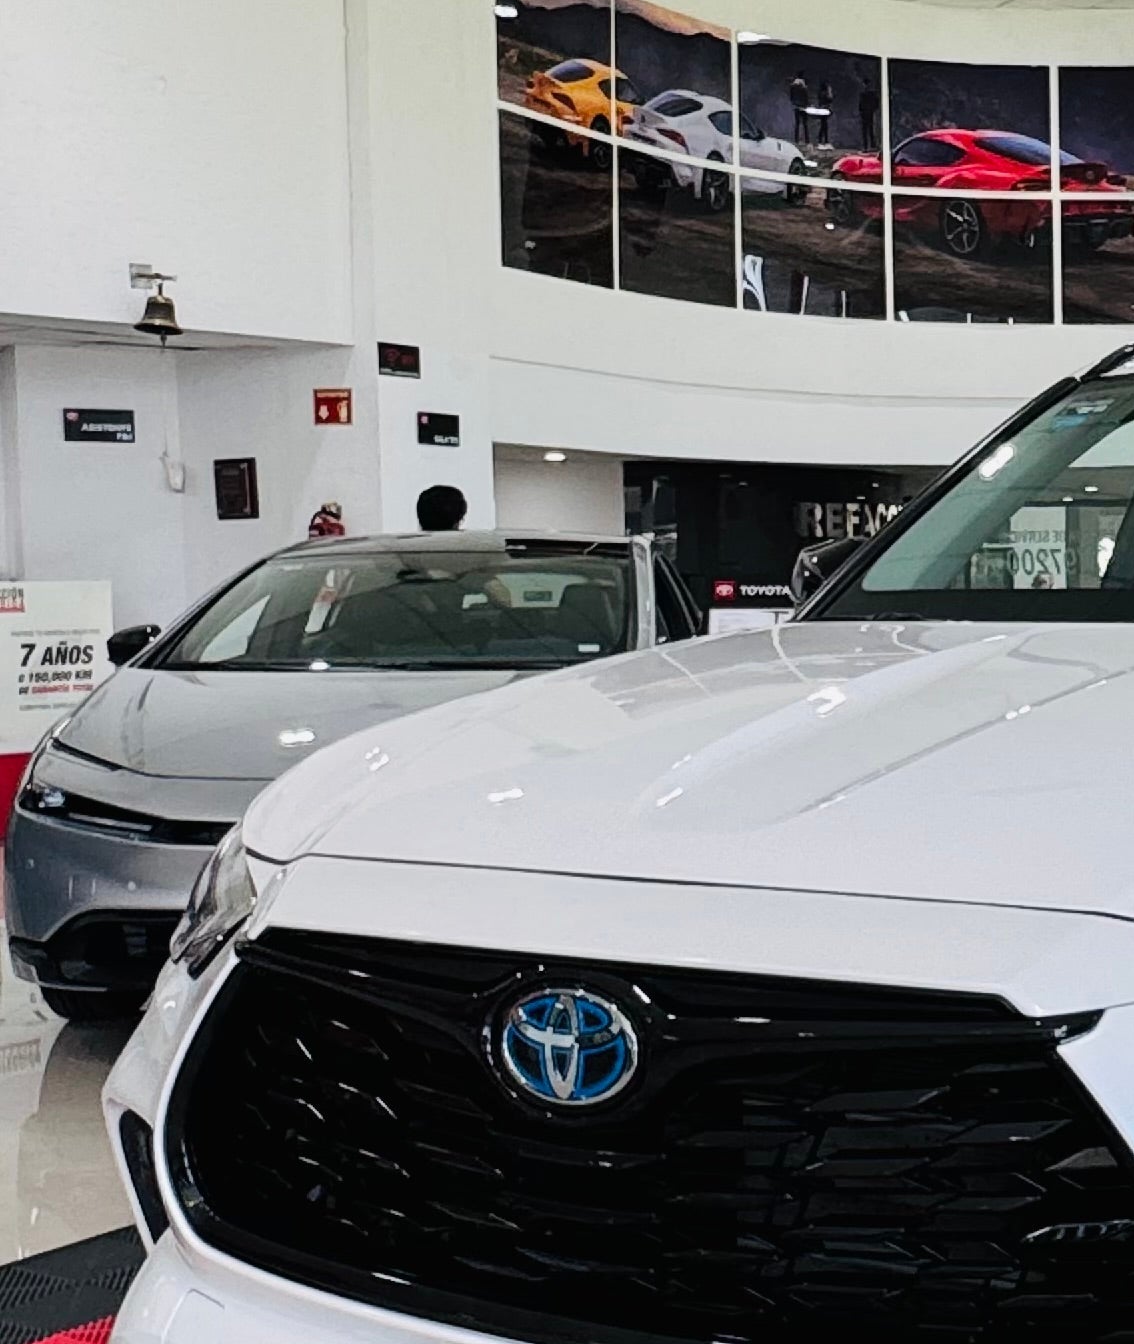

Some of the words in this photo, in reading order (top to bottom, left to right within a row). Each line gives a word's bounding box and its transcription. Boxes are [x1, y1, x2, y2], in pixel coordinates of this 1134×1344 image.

[798, 502, 903, 538] REFAC
[739, 585, 791, 596] TOYOTA
[20, 643, 36, 667] 7
[41, 640, 94, 665] AÑOS
